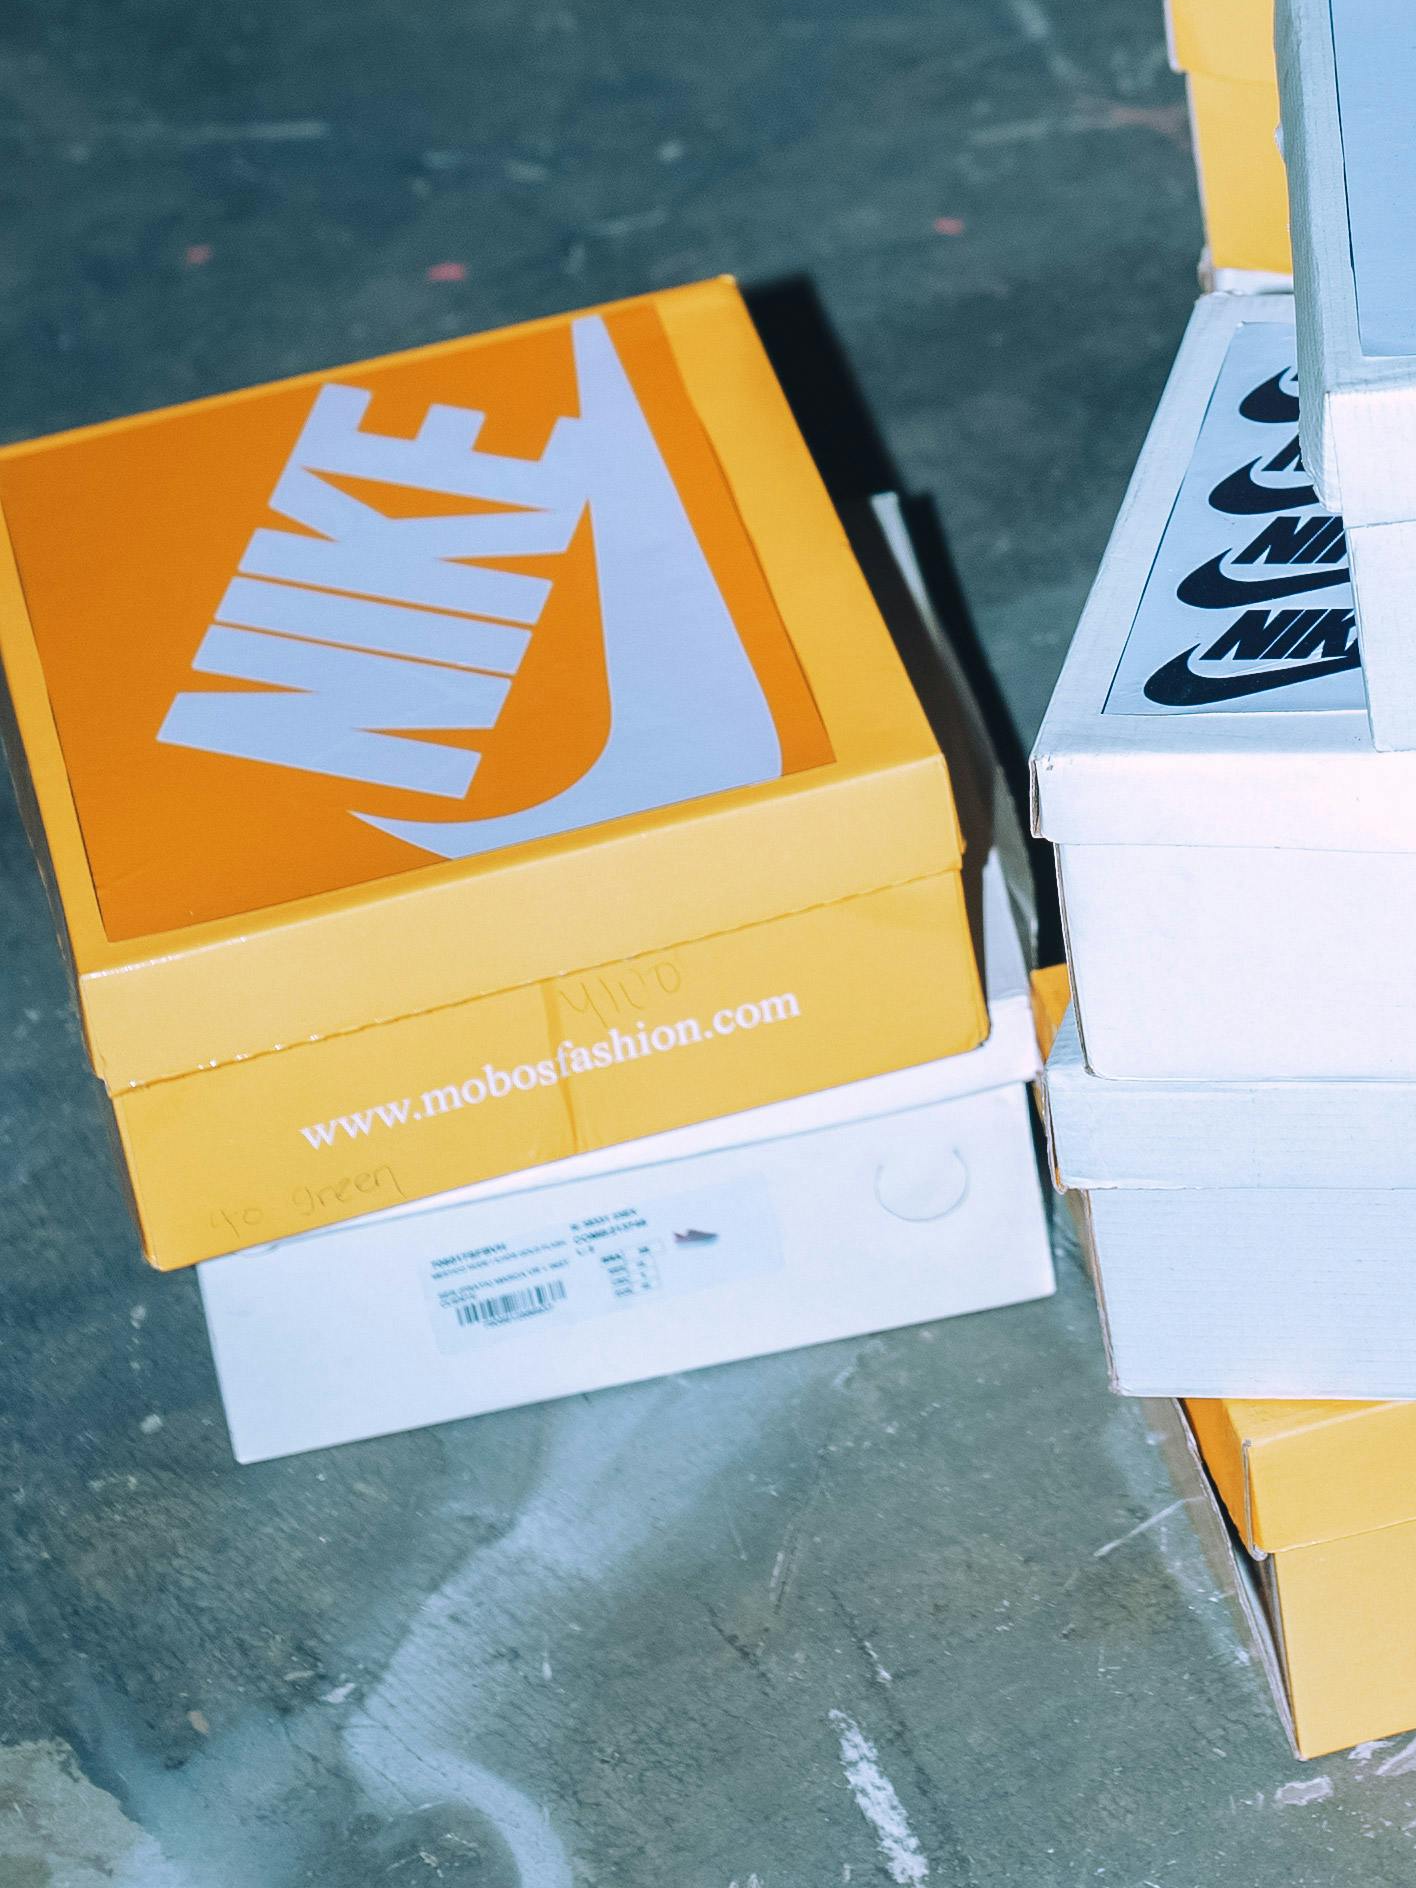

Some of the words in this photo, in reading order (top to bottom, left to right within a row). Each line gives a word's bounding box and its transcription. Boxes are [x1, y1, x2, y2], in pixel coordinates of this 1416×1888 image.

[1230, 516, 1348, 565] NI
[155, 382, 582, 800] NIKE
[1199, 608, 1360, 661] NIK
[299, 990, 803, 1154] www.mobosfashion.com
[290, 1165, 409, 1217] green
